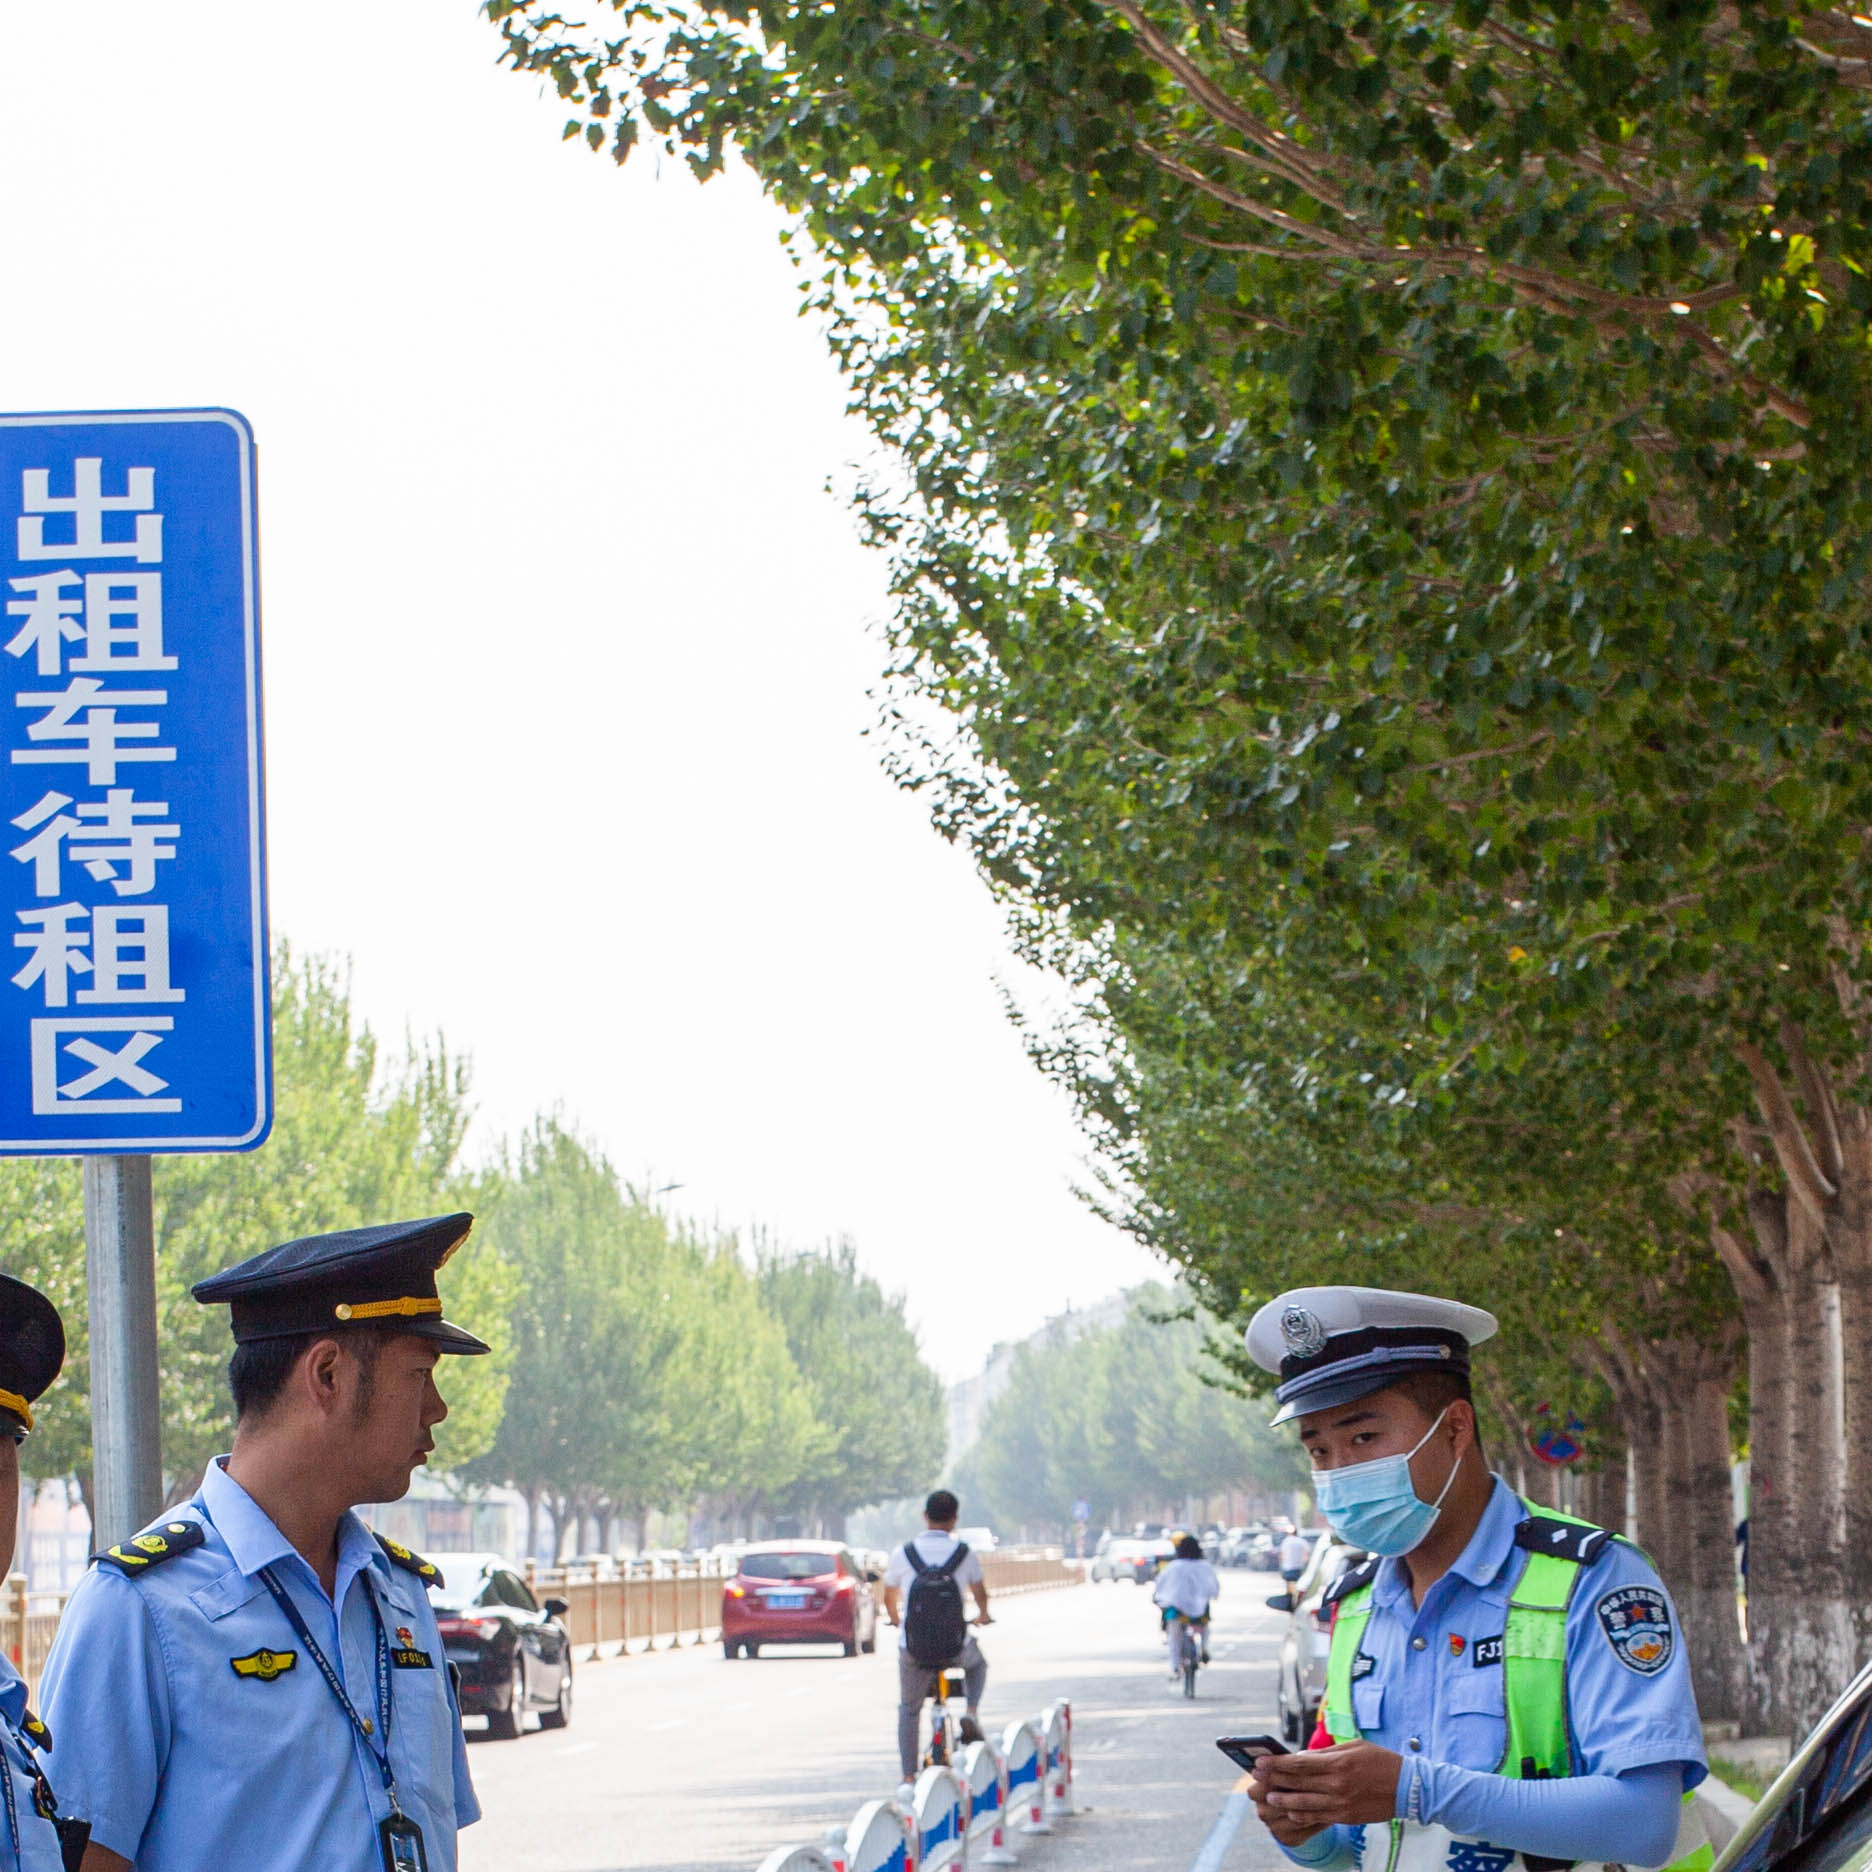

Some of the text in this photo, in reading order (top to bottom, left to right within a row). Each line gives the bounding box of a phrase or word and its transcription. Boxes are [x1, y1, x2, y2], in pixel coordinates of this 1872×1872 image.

[4, 457, 185, 1114] 出租车待租区
